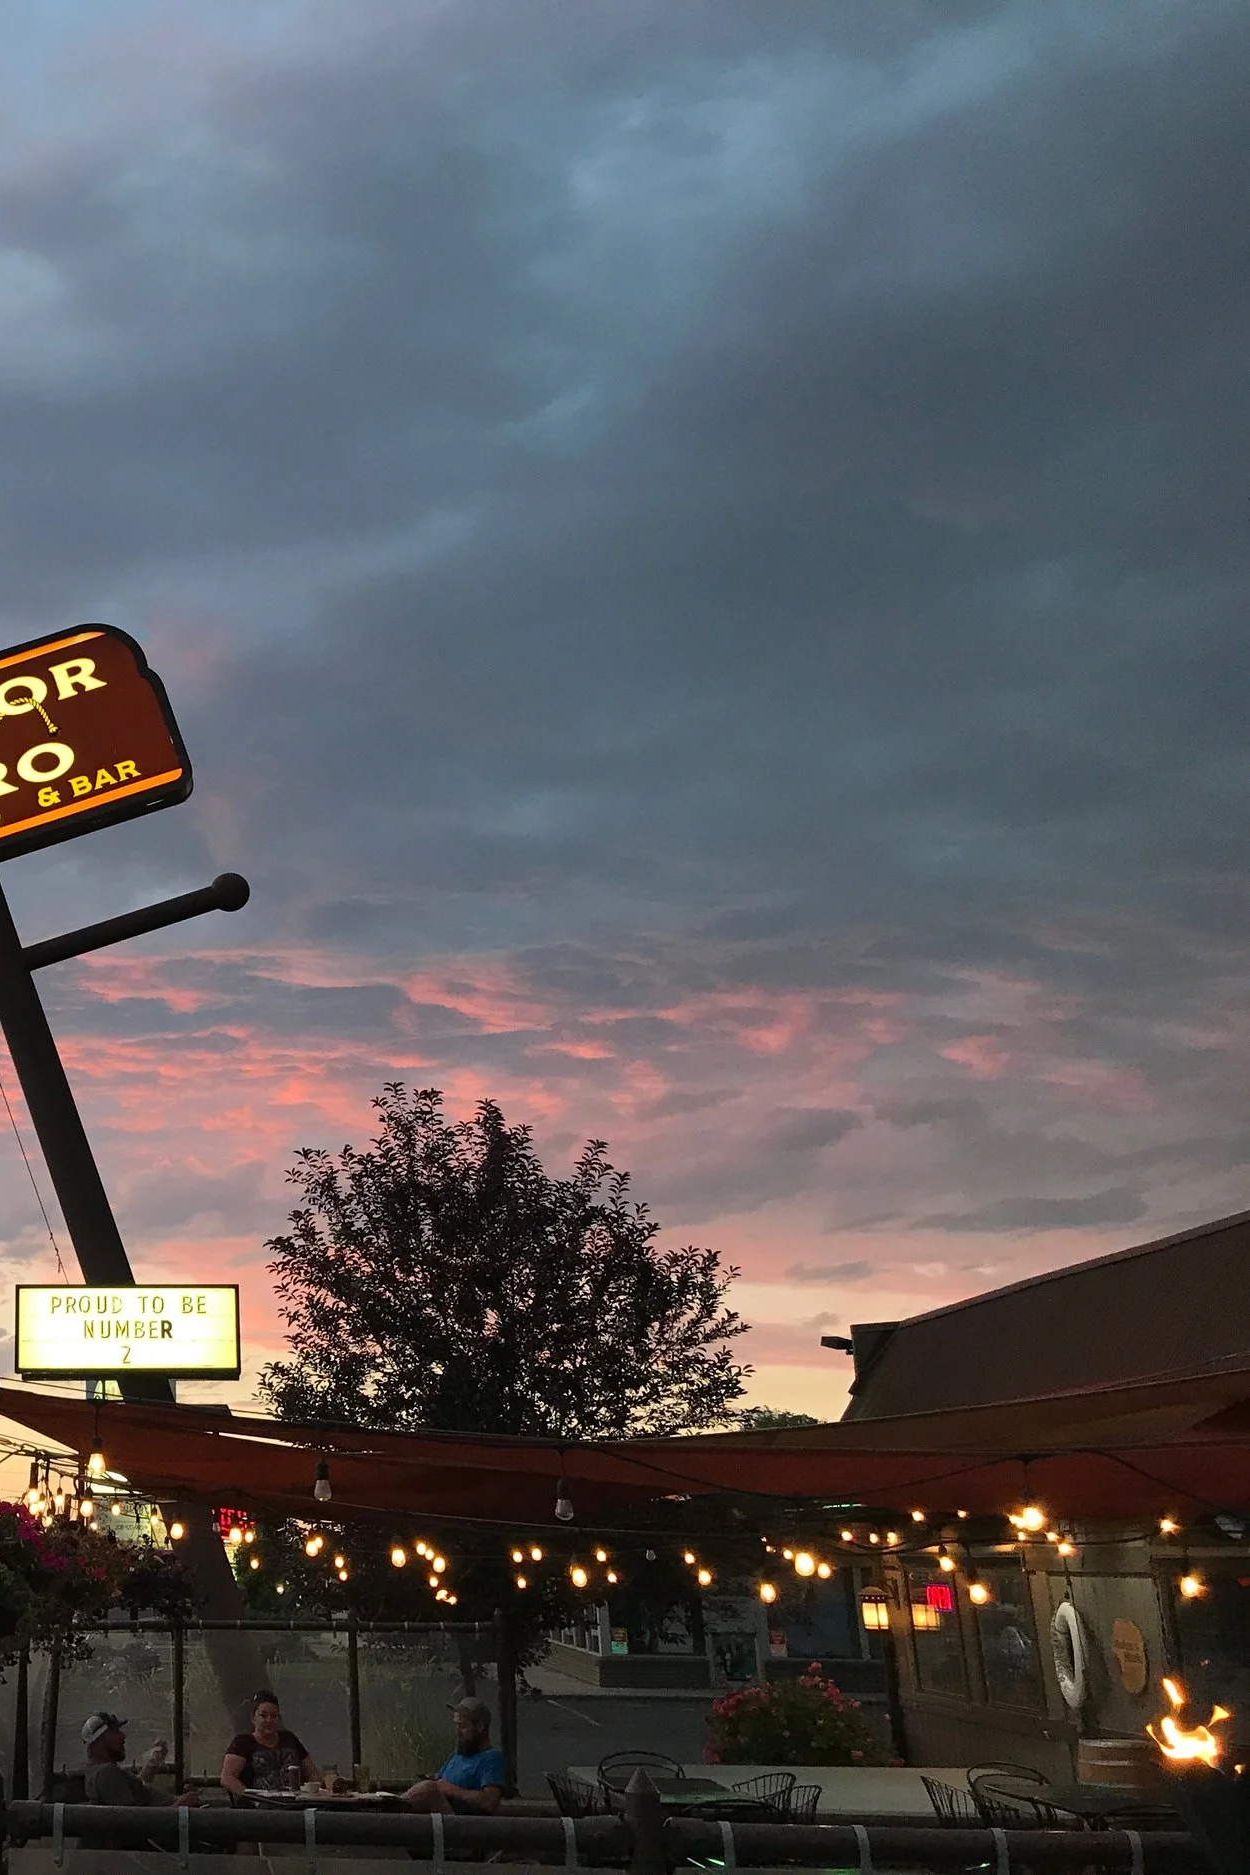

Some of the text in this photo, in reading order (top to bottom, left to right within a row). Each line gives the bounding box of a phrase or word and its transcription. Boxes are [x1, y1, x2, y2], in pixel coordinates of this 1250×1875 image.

[38, 760, 141, 807] & BAR
[51, 1296, 207, 1314] PROUD TO BE
[84, 1320, 173, 1338] NUMBER
[121, 1346, 131, 1364] 2
